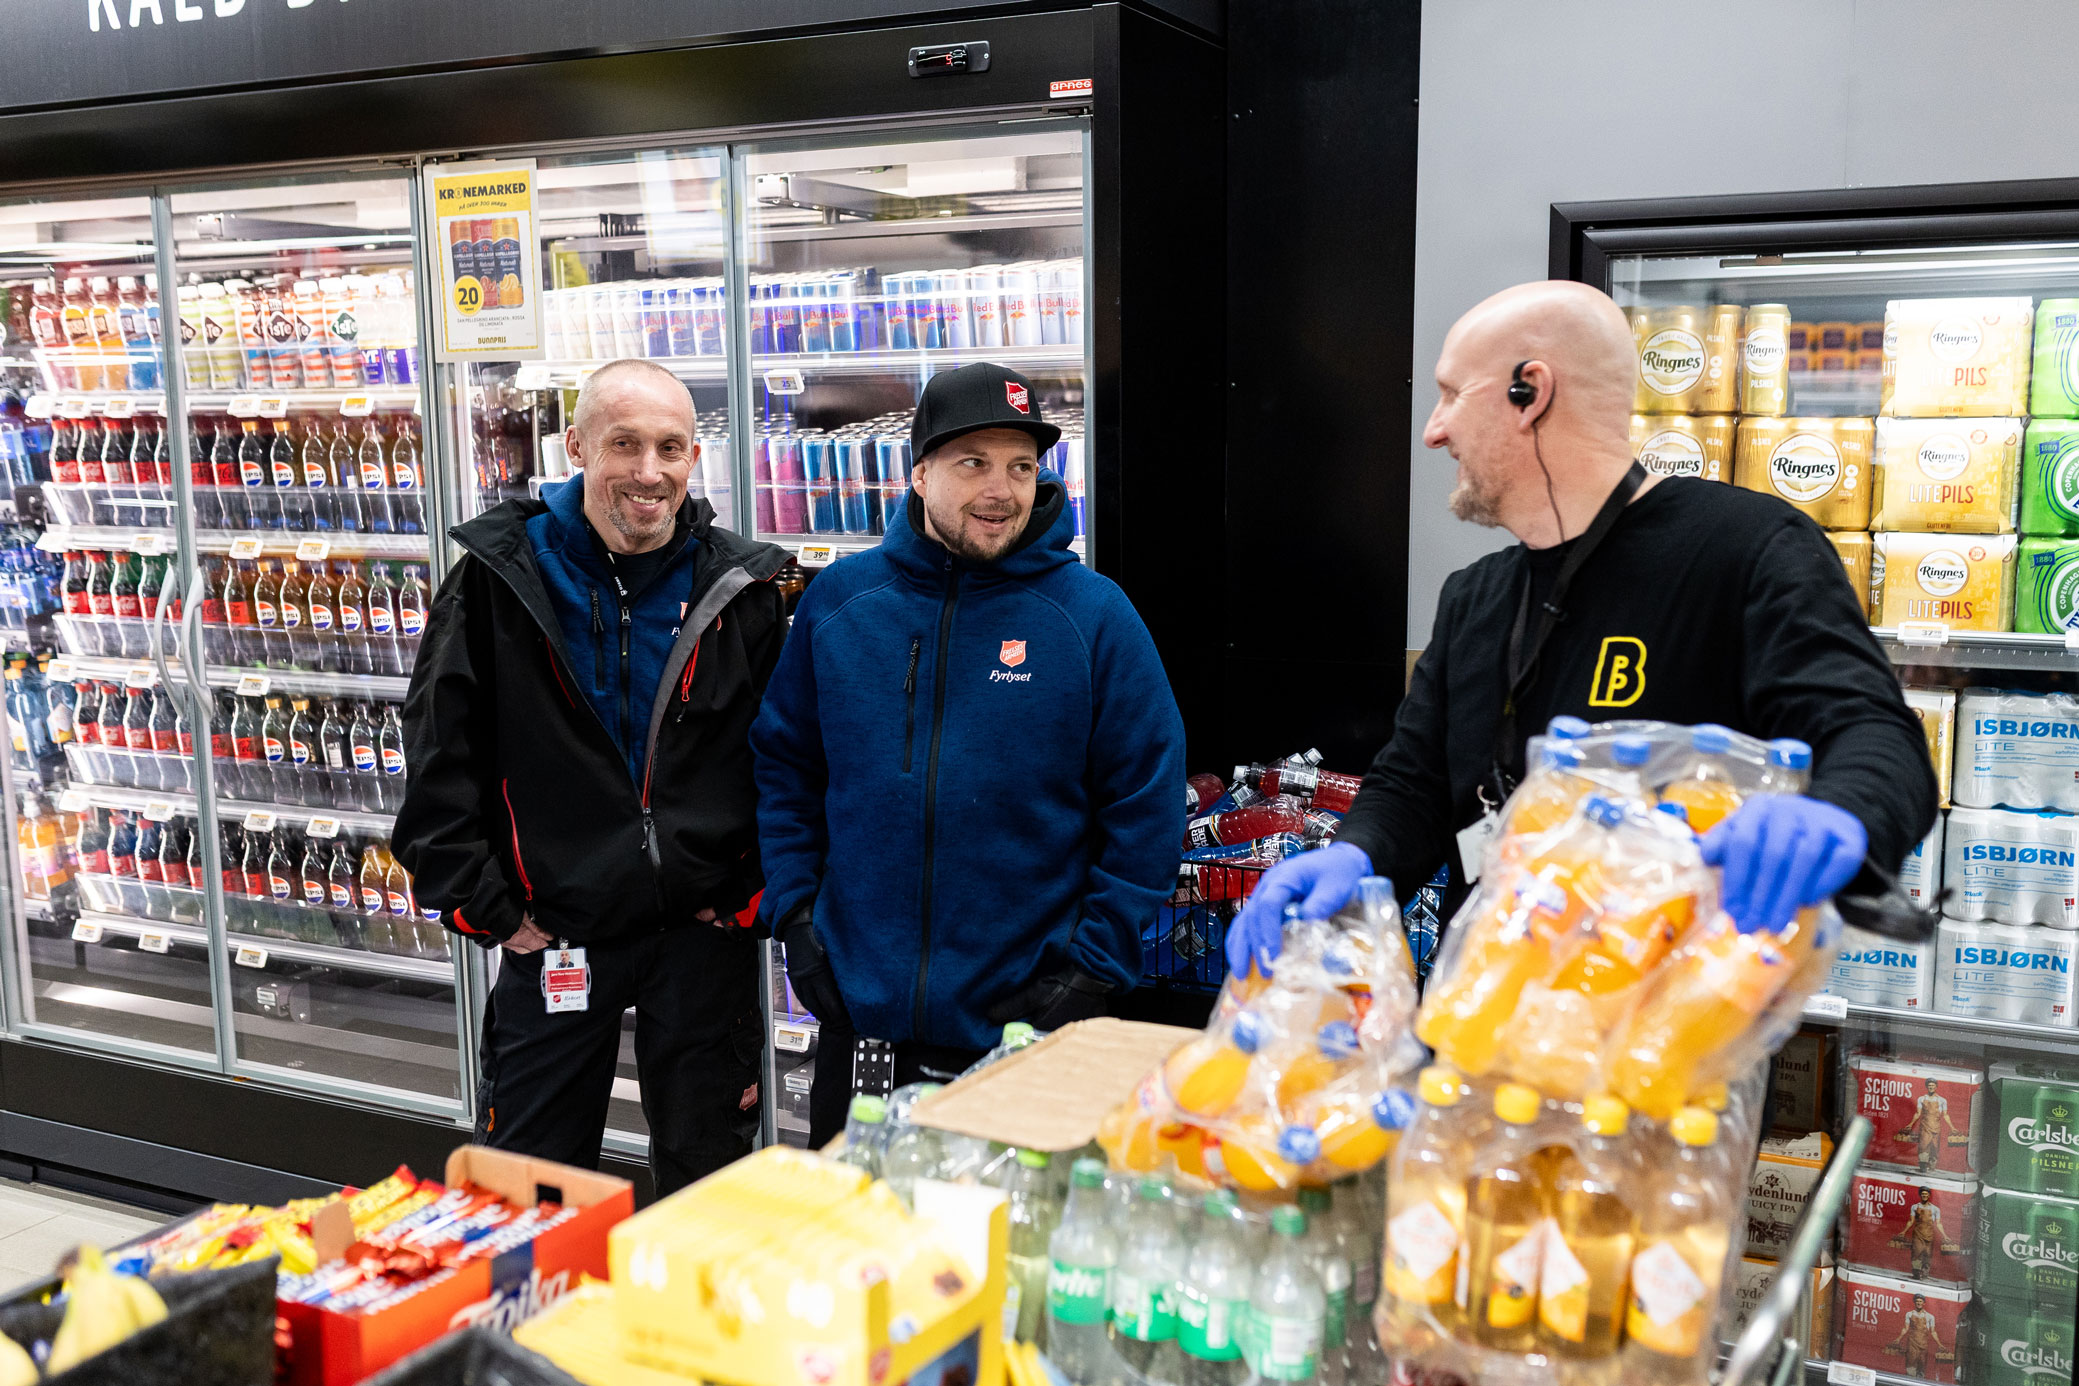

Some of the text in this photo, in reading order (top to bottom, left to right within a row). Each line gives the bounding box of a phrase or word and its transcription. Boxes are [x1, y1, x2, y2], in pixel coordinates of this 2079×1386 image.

[458, 287, 479, 305] 20
[1933, 332, 1978, 346] Ringnes
[1747, 343, 1784, 358] Ringnes
[1643, 351, 1701, 373] Ringnes
[1641, 453, 1701, 475] Ringnes
[1921, 449, 1966, 464] Ringnes
[1774, 457, 1836, 478] Ringnes
[1920, 565, 1965, 580] Ringnes
[989, 670, 1032, 683] Fyrlyset
[1975, 742, 2016, 751] LITE
[1963, 845, 2075, 867] ISBJØRN
[1964, 866, 2005, 878] LITE
[1840, 950, 1917, 968] BJØRN
[1955, 947, 2068, 974] ISBJØRN
[1953, 971, 1995, 982] LITE
[1864, 1077, 1913, 1099] SCHOUS
[1863, 1093, 1890, 1111] PILS
[2008, 1116, 2079, 1146] Carlsbe
[1748, 1185, 1811, 1204] ydenlund
[1858, 1184, 1907, 1207] SCHOUS
[1750, 1200, 1797, 1214] UICY IPA
[1857, 1199, 1884, 1218] PILS
[2002, 1232, 2079, 1263] Carlsbe
[1853, 1290, 1901, 1313] SCHOUS
[1852, 1305, 1879, 1325] PILS
[2001, 1339, 2073, 1371] Carlsbe
